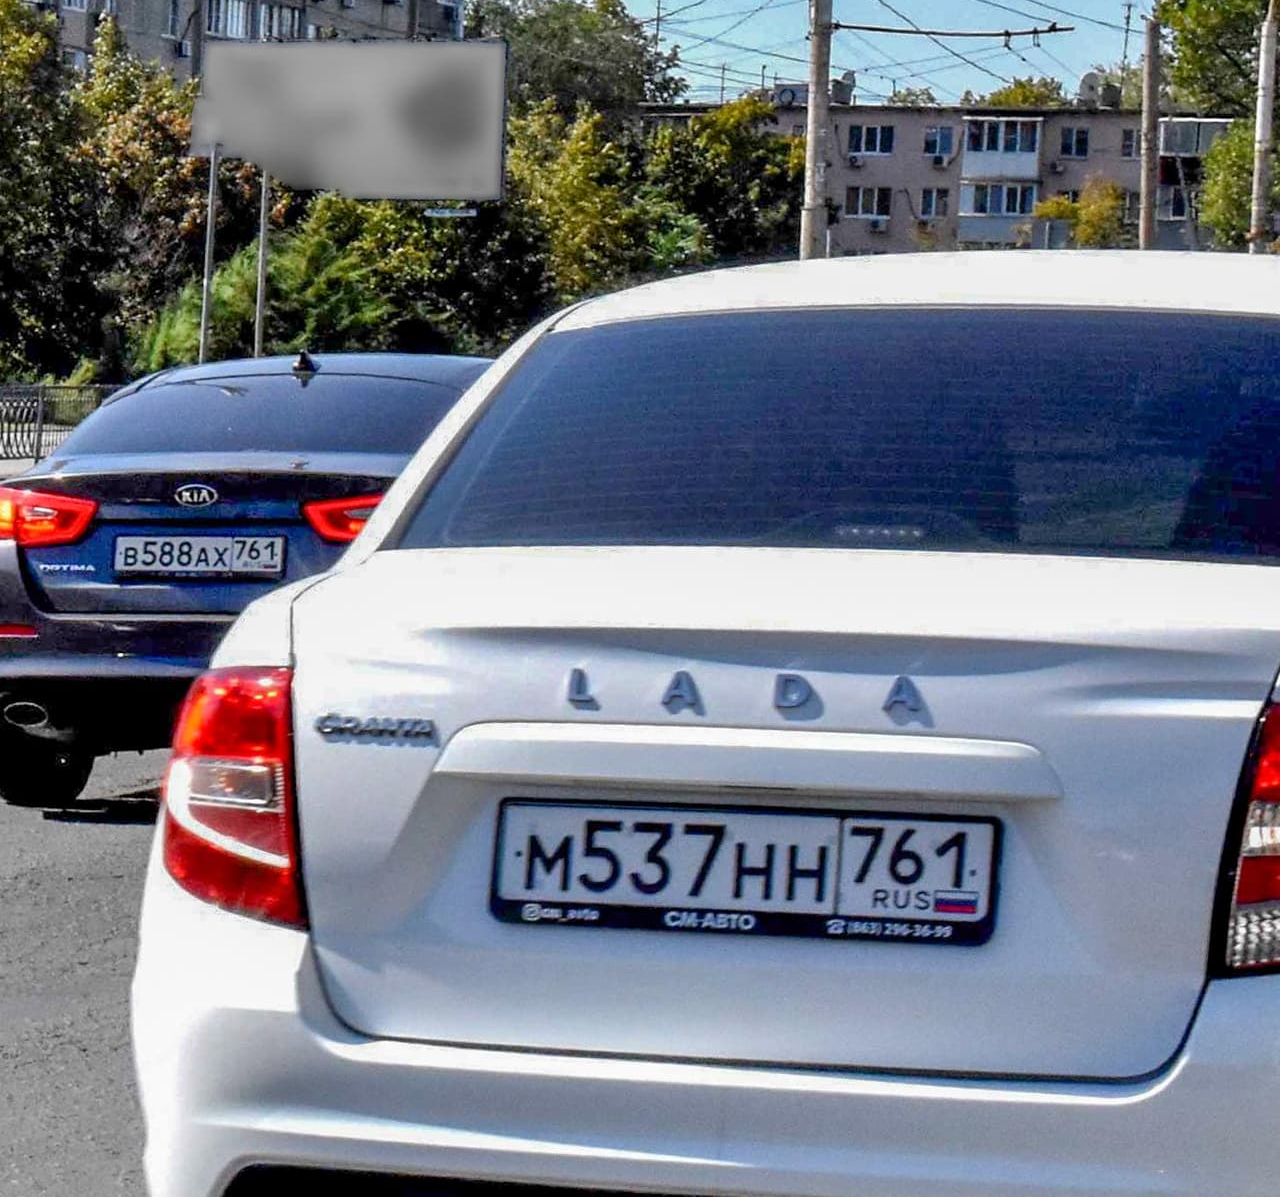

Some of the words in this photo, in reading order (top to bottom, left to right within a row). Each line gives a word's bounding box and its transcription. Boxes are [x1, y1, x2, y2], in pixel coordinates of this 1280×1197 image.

[181, 488, 210, 503] KIA
[235, 539, 276, 561] 761
[567, 668, 928, 717] LADA
[315, 713, 435, 740] GRANTA
[850, 825, 968, 888] 761
[872, 889, 931, 910] RUS
